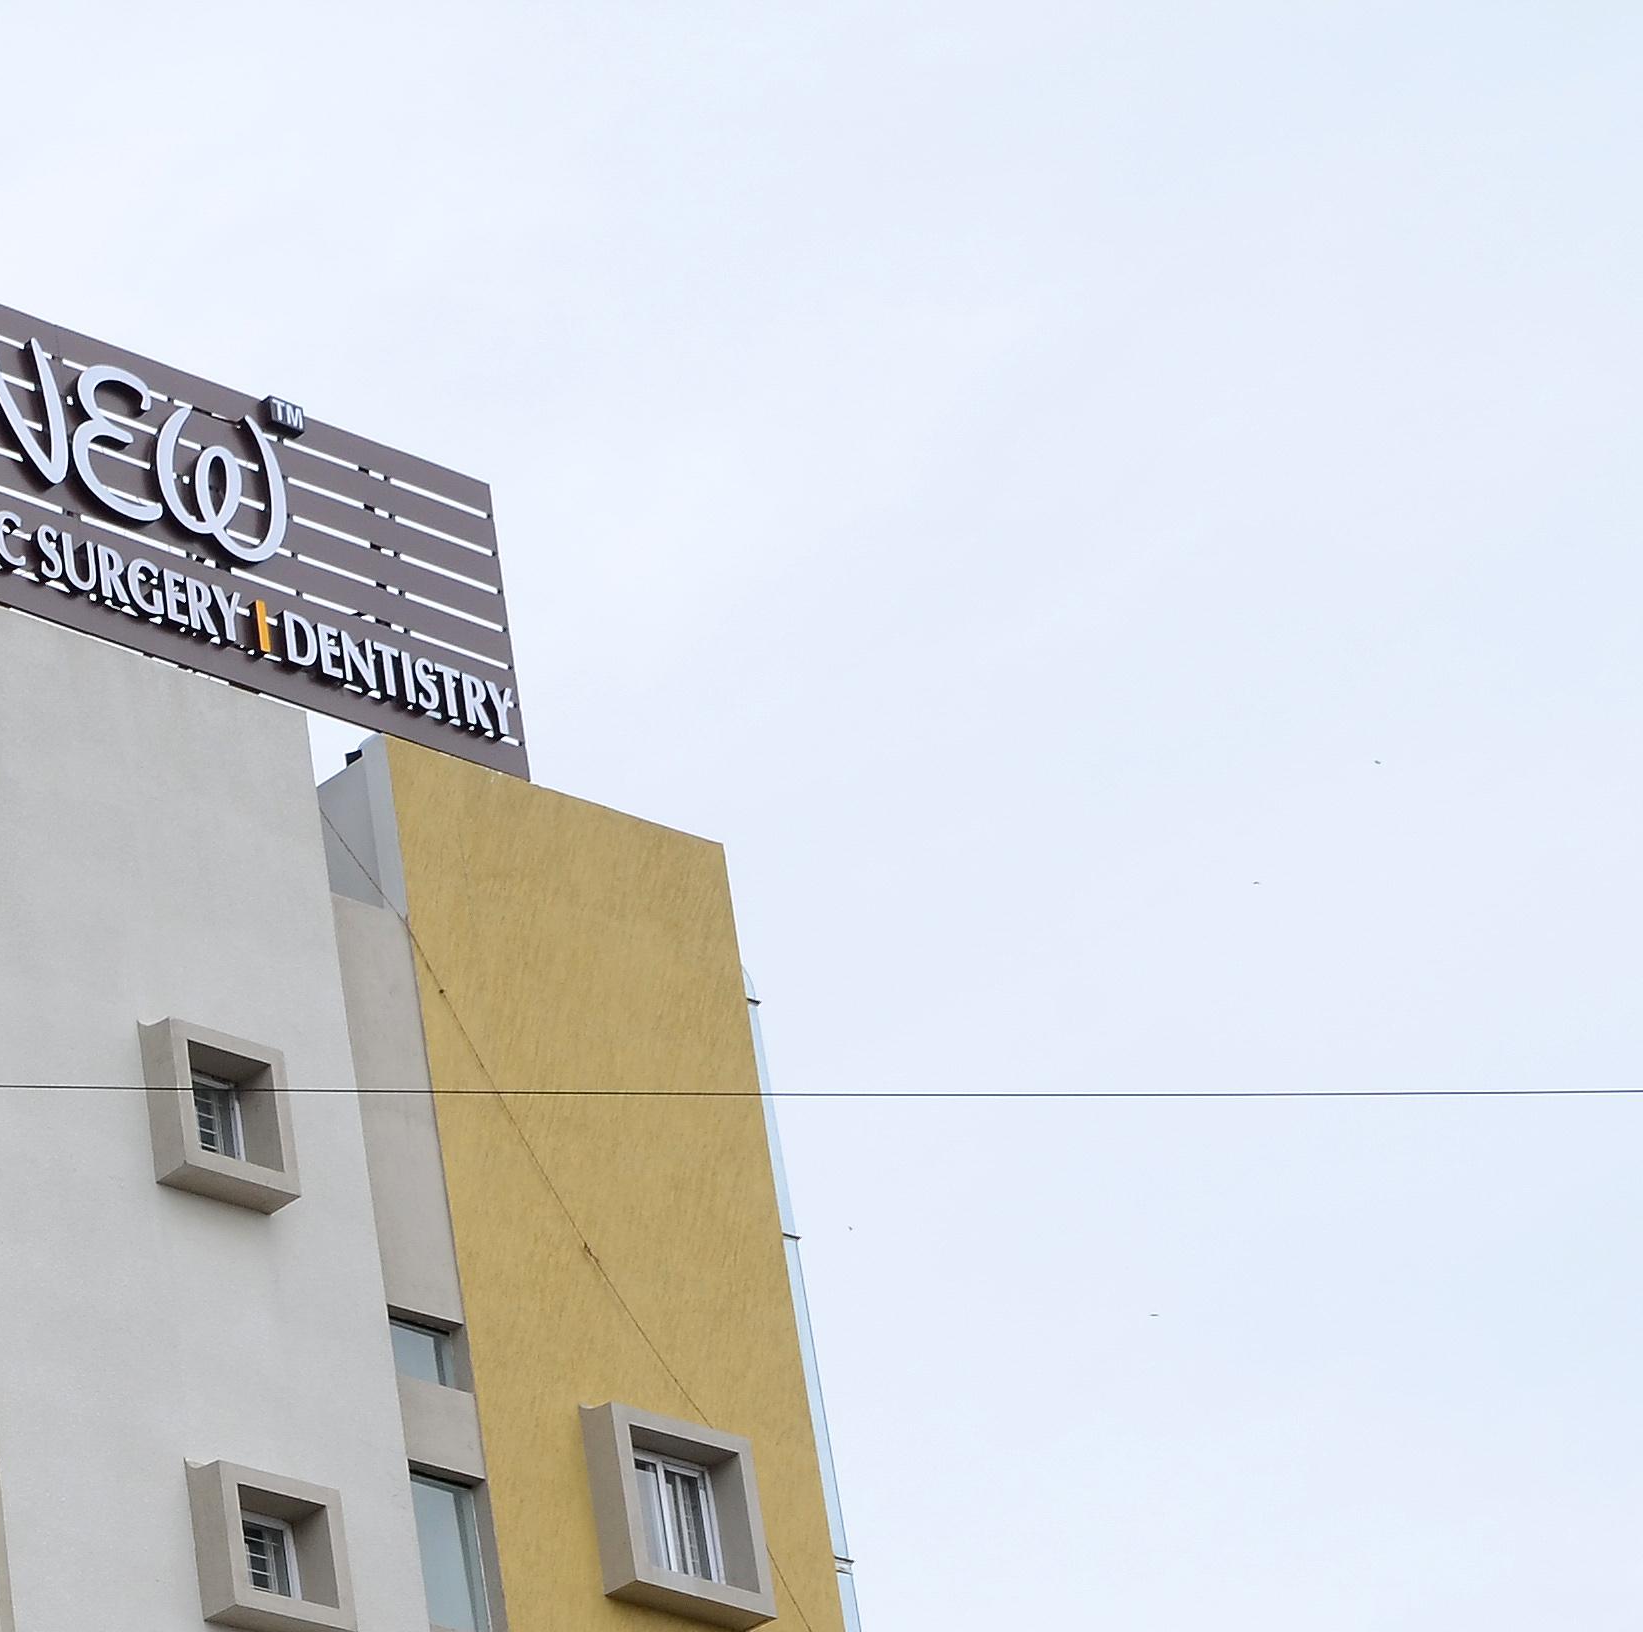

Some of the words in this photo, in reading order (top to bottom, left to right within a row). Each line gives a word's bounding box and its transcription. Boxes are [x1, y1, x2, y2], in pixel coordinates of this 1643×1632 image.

[272, 400, 308, 430] TM
[35, 524, 242, 642] SURGERY
[283, 610, 513, 735] DENTISTRY
